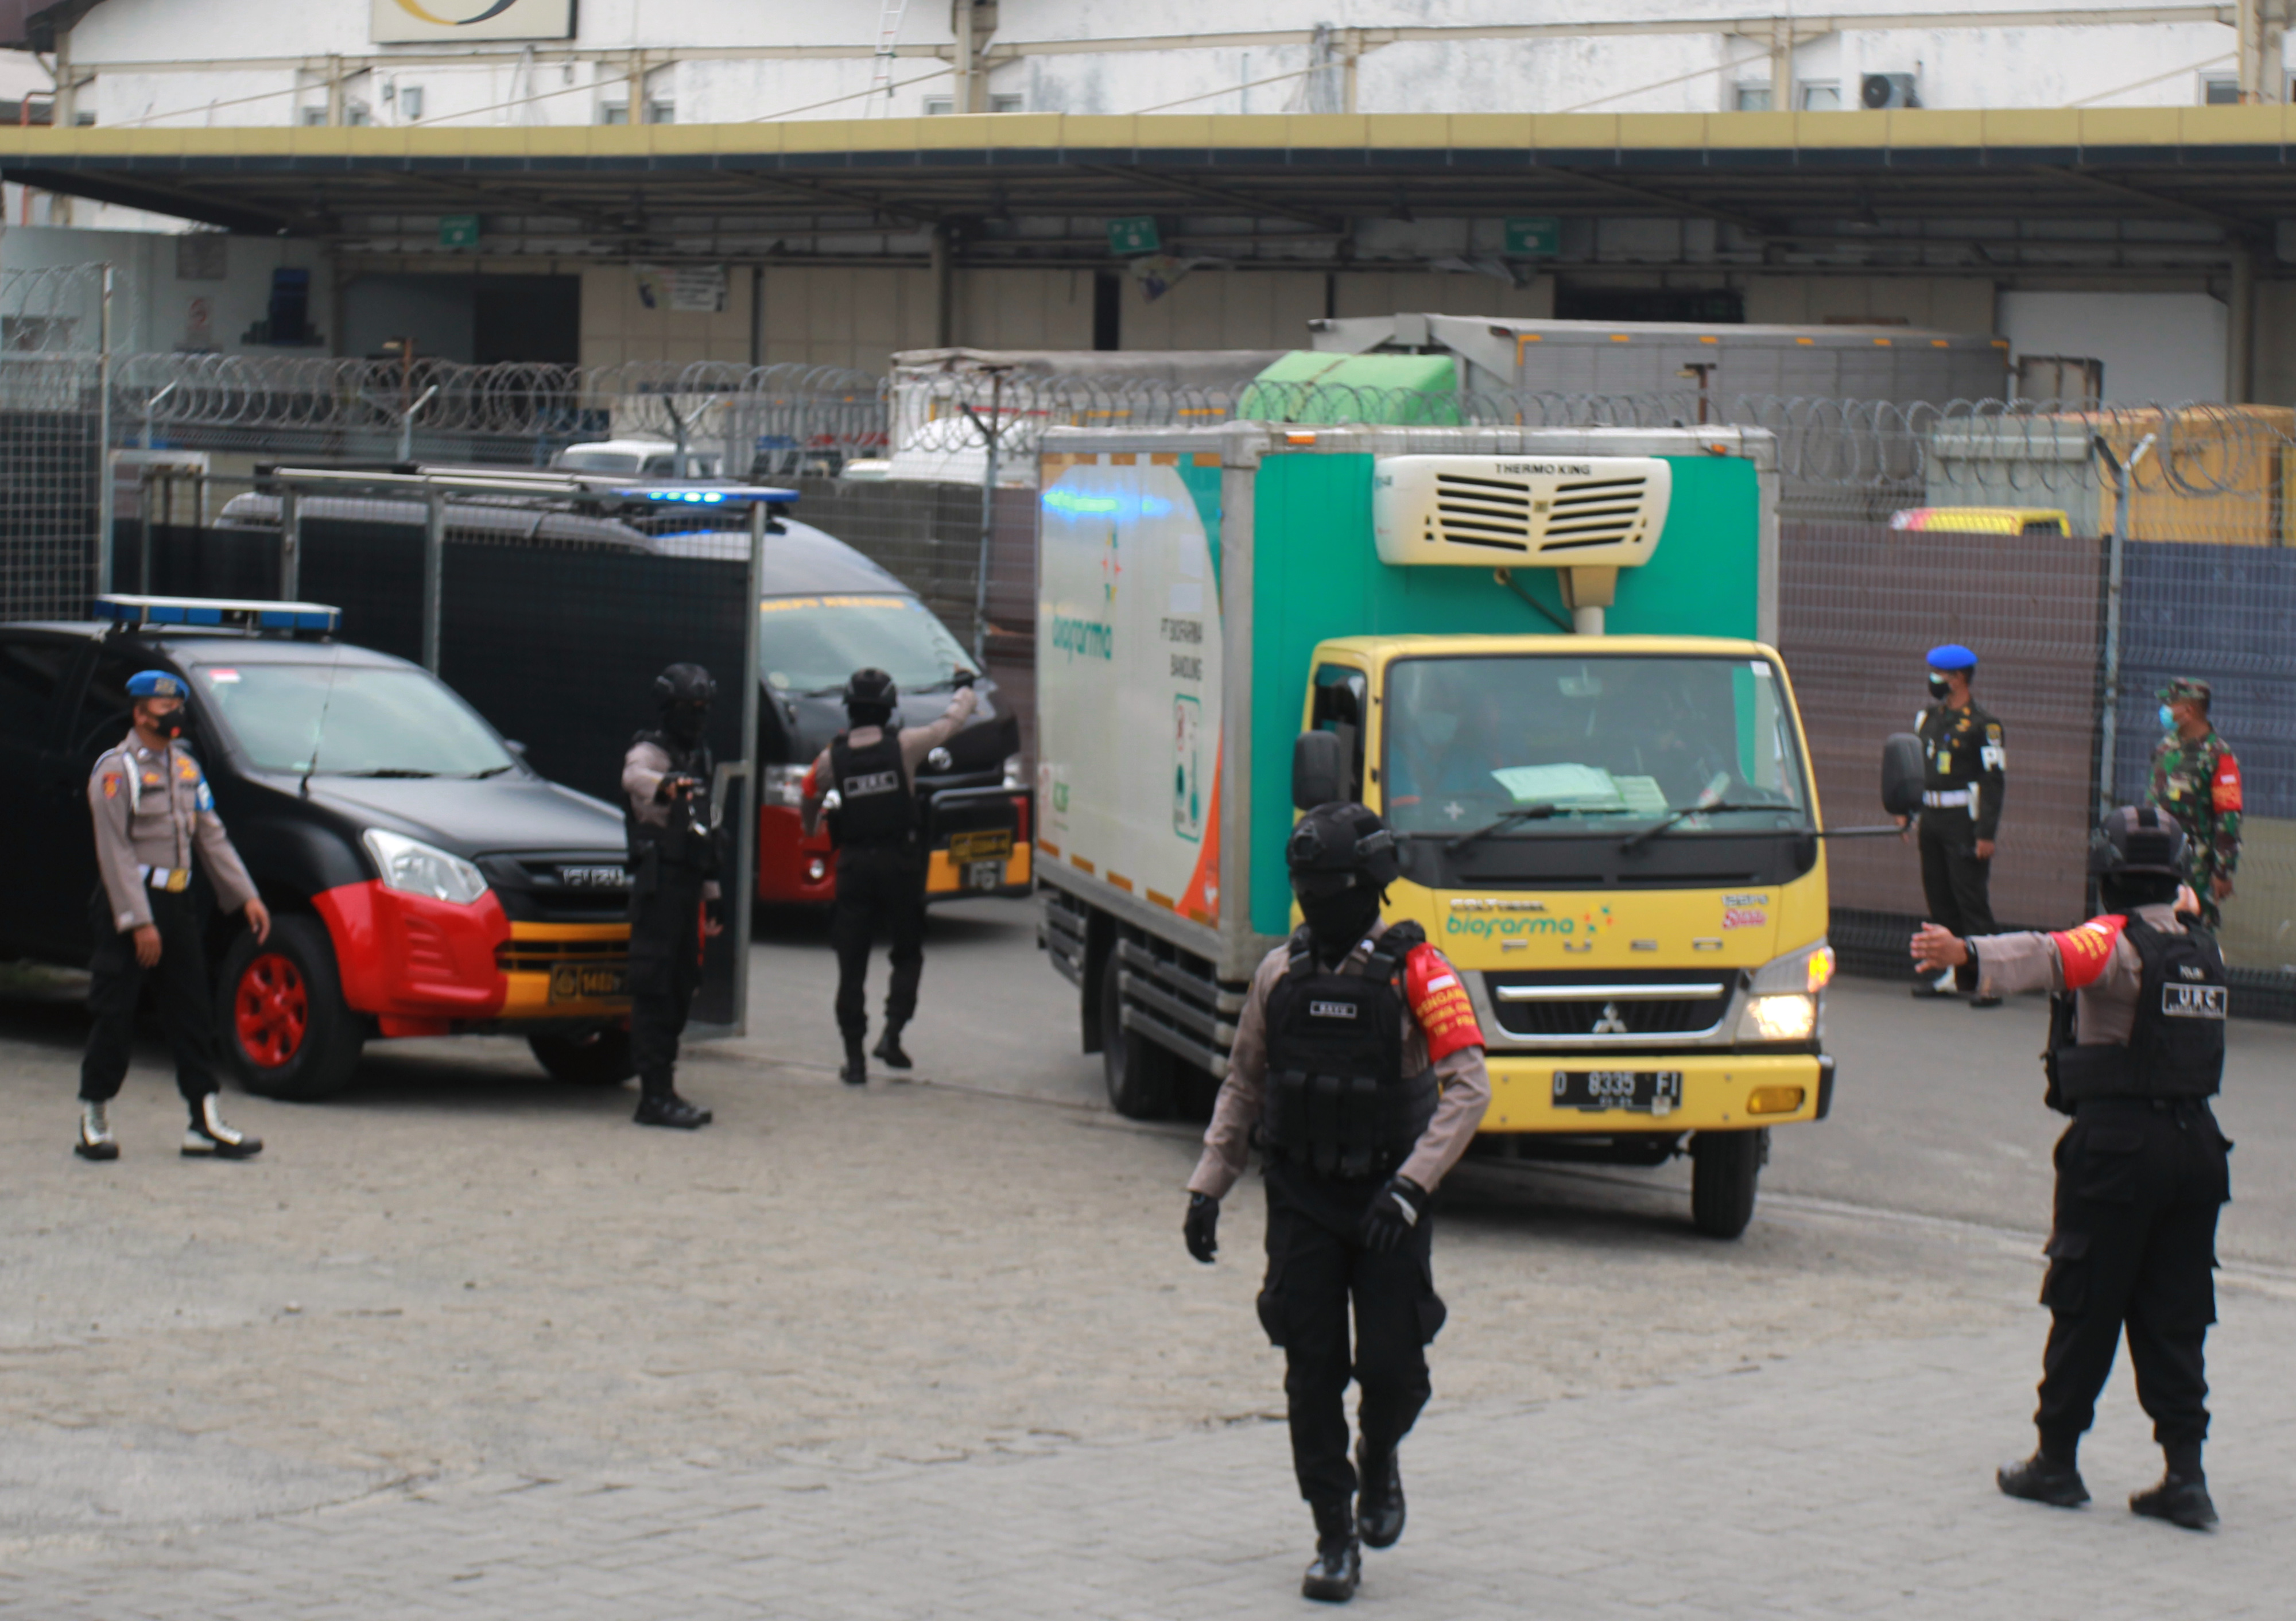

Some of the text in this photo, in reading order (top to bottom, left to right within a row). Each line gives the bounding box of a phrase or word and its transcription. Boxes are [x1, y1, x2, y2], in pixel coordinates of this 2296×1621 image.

[1495, 463, 1591, 475] THERMO KING
[1446, 912, 1574, 940] biofarma
[1553, 1071, 1567, 1096] D
[1588, 1071, 1635, 1097] 8335
